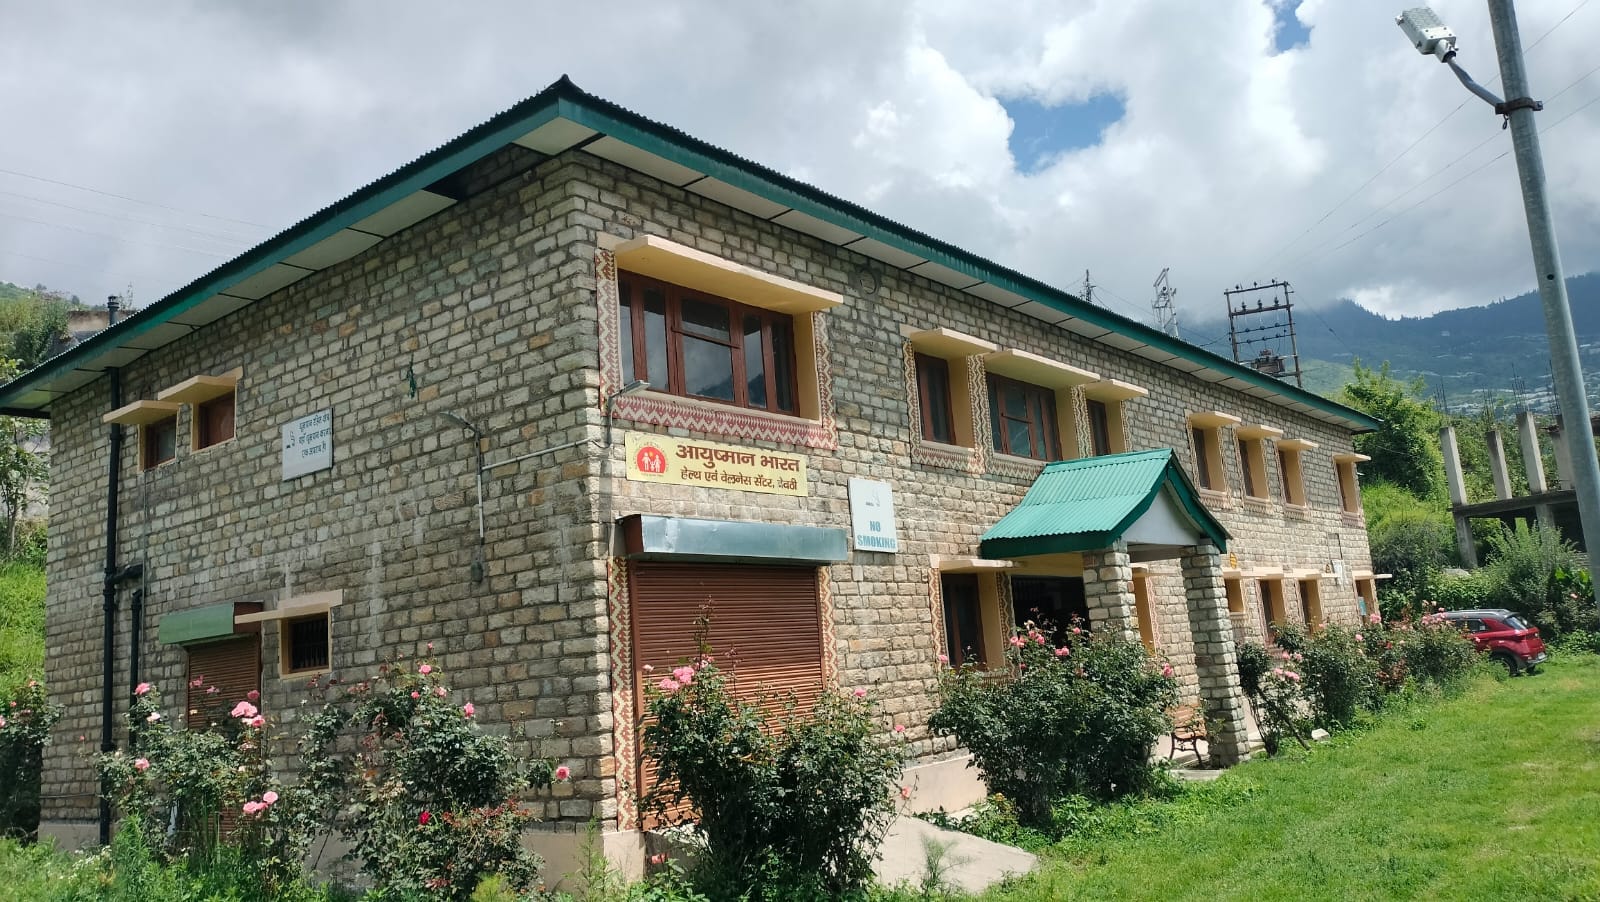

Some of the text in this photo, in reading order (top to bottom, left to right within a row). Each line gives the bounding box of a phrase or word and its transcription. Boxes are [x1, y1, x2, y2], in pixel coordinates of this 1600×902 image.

[676, 444, 756, 469] आयुष्मान
[760, 454, 800, 472] भारत
[680, 465, 702, 481] हेल्थ
[704, 469, 718, 482] एवं
[720, 470, 752, 486] वेलनेस
[869, 520, 881, 533] NO
[856, 534, 896, 549] SMOKING
